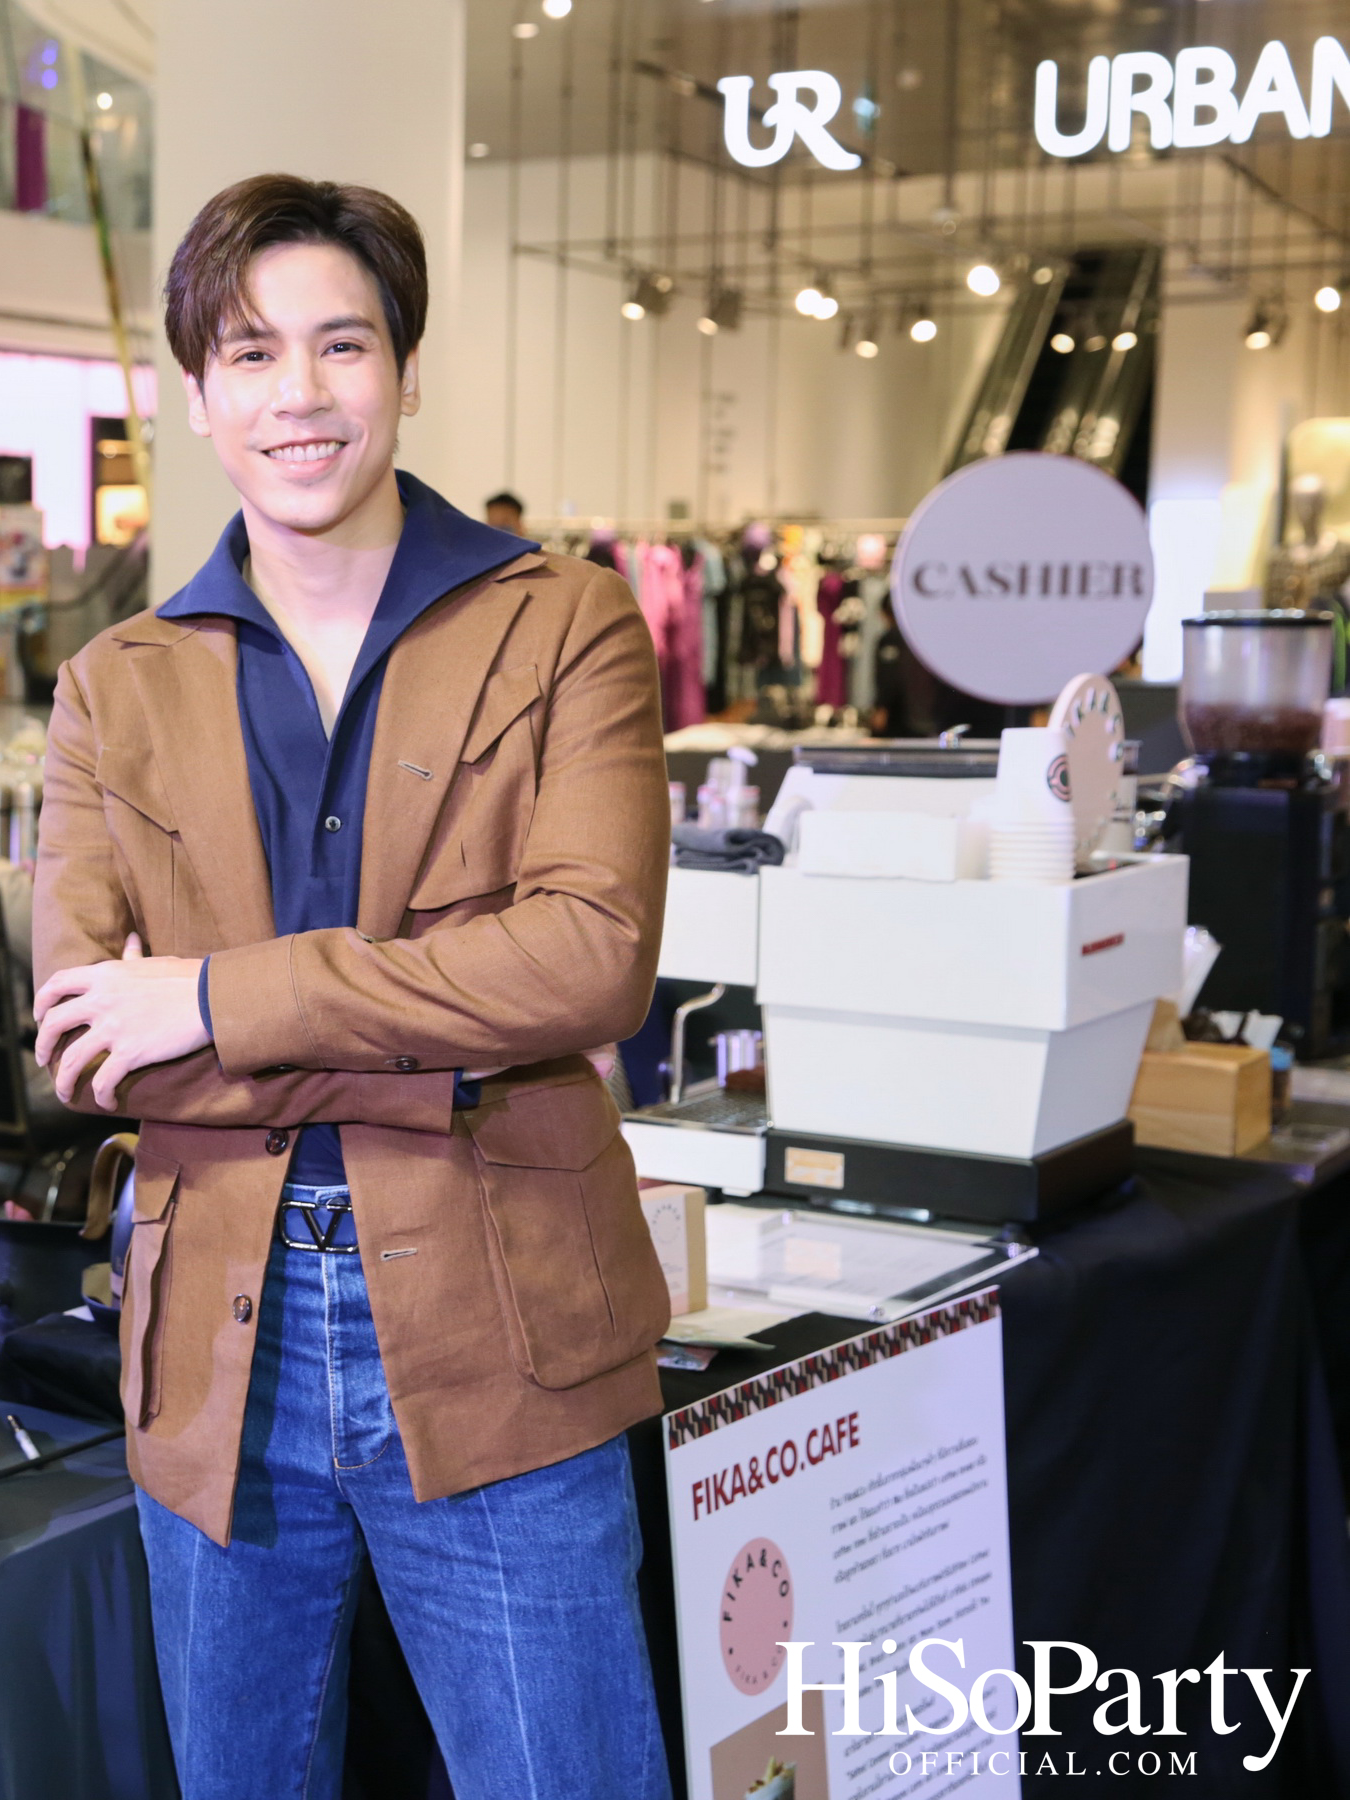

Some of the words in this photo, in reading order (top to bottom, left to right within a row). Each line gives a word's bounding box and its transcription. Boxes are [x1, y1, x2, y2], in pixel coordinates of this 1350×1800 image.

[717, 69, 862, 171] UR
[911, 558, 1145, 600] CASHIER
[692, 1411, 860, 1522] FIKA&CO.CAFE
